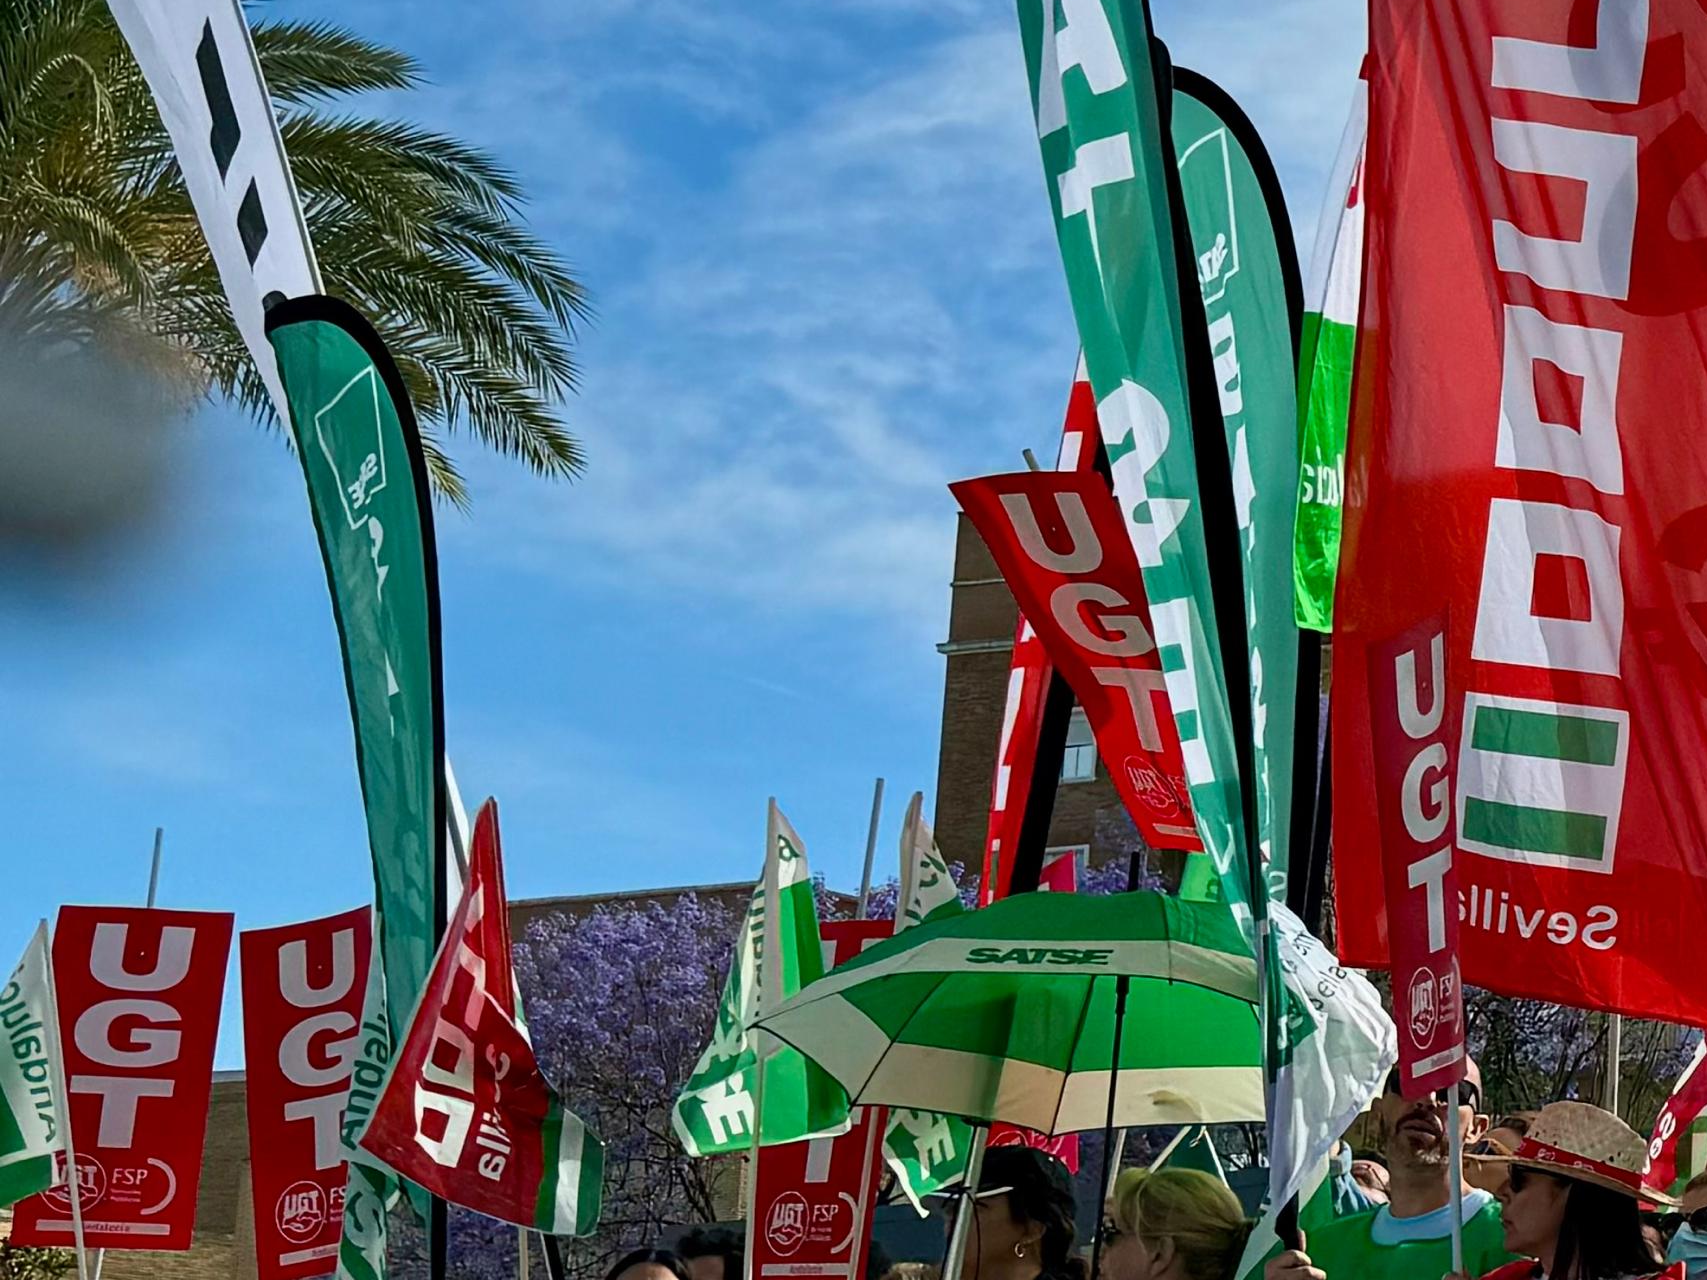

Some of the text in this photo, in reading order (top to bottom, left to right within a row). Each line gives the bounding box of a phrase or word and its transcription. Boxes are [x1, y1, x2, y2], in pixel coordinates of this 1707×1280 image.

[998, 492, 1172, 754] UGT
[1394, 631, 1453, 955] UGT
[70, 922, 196, 1149] UGT
[278, 927, 357, 1171] UGT
[965, 947, 1115, 967] SATSE
[111, 1167, 148, 1186] FSP
[812, 1204, 839, 1223] FSP
